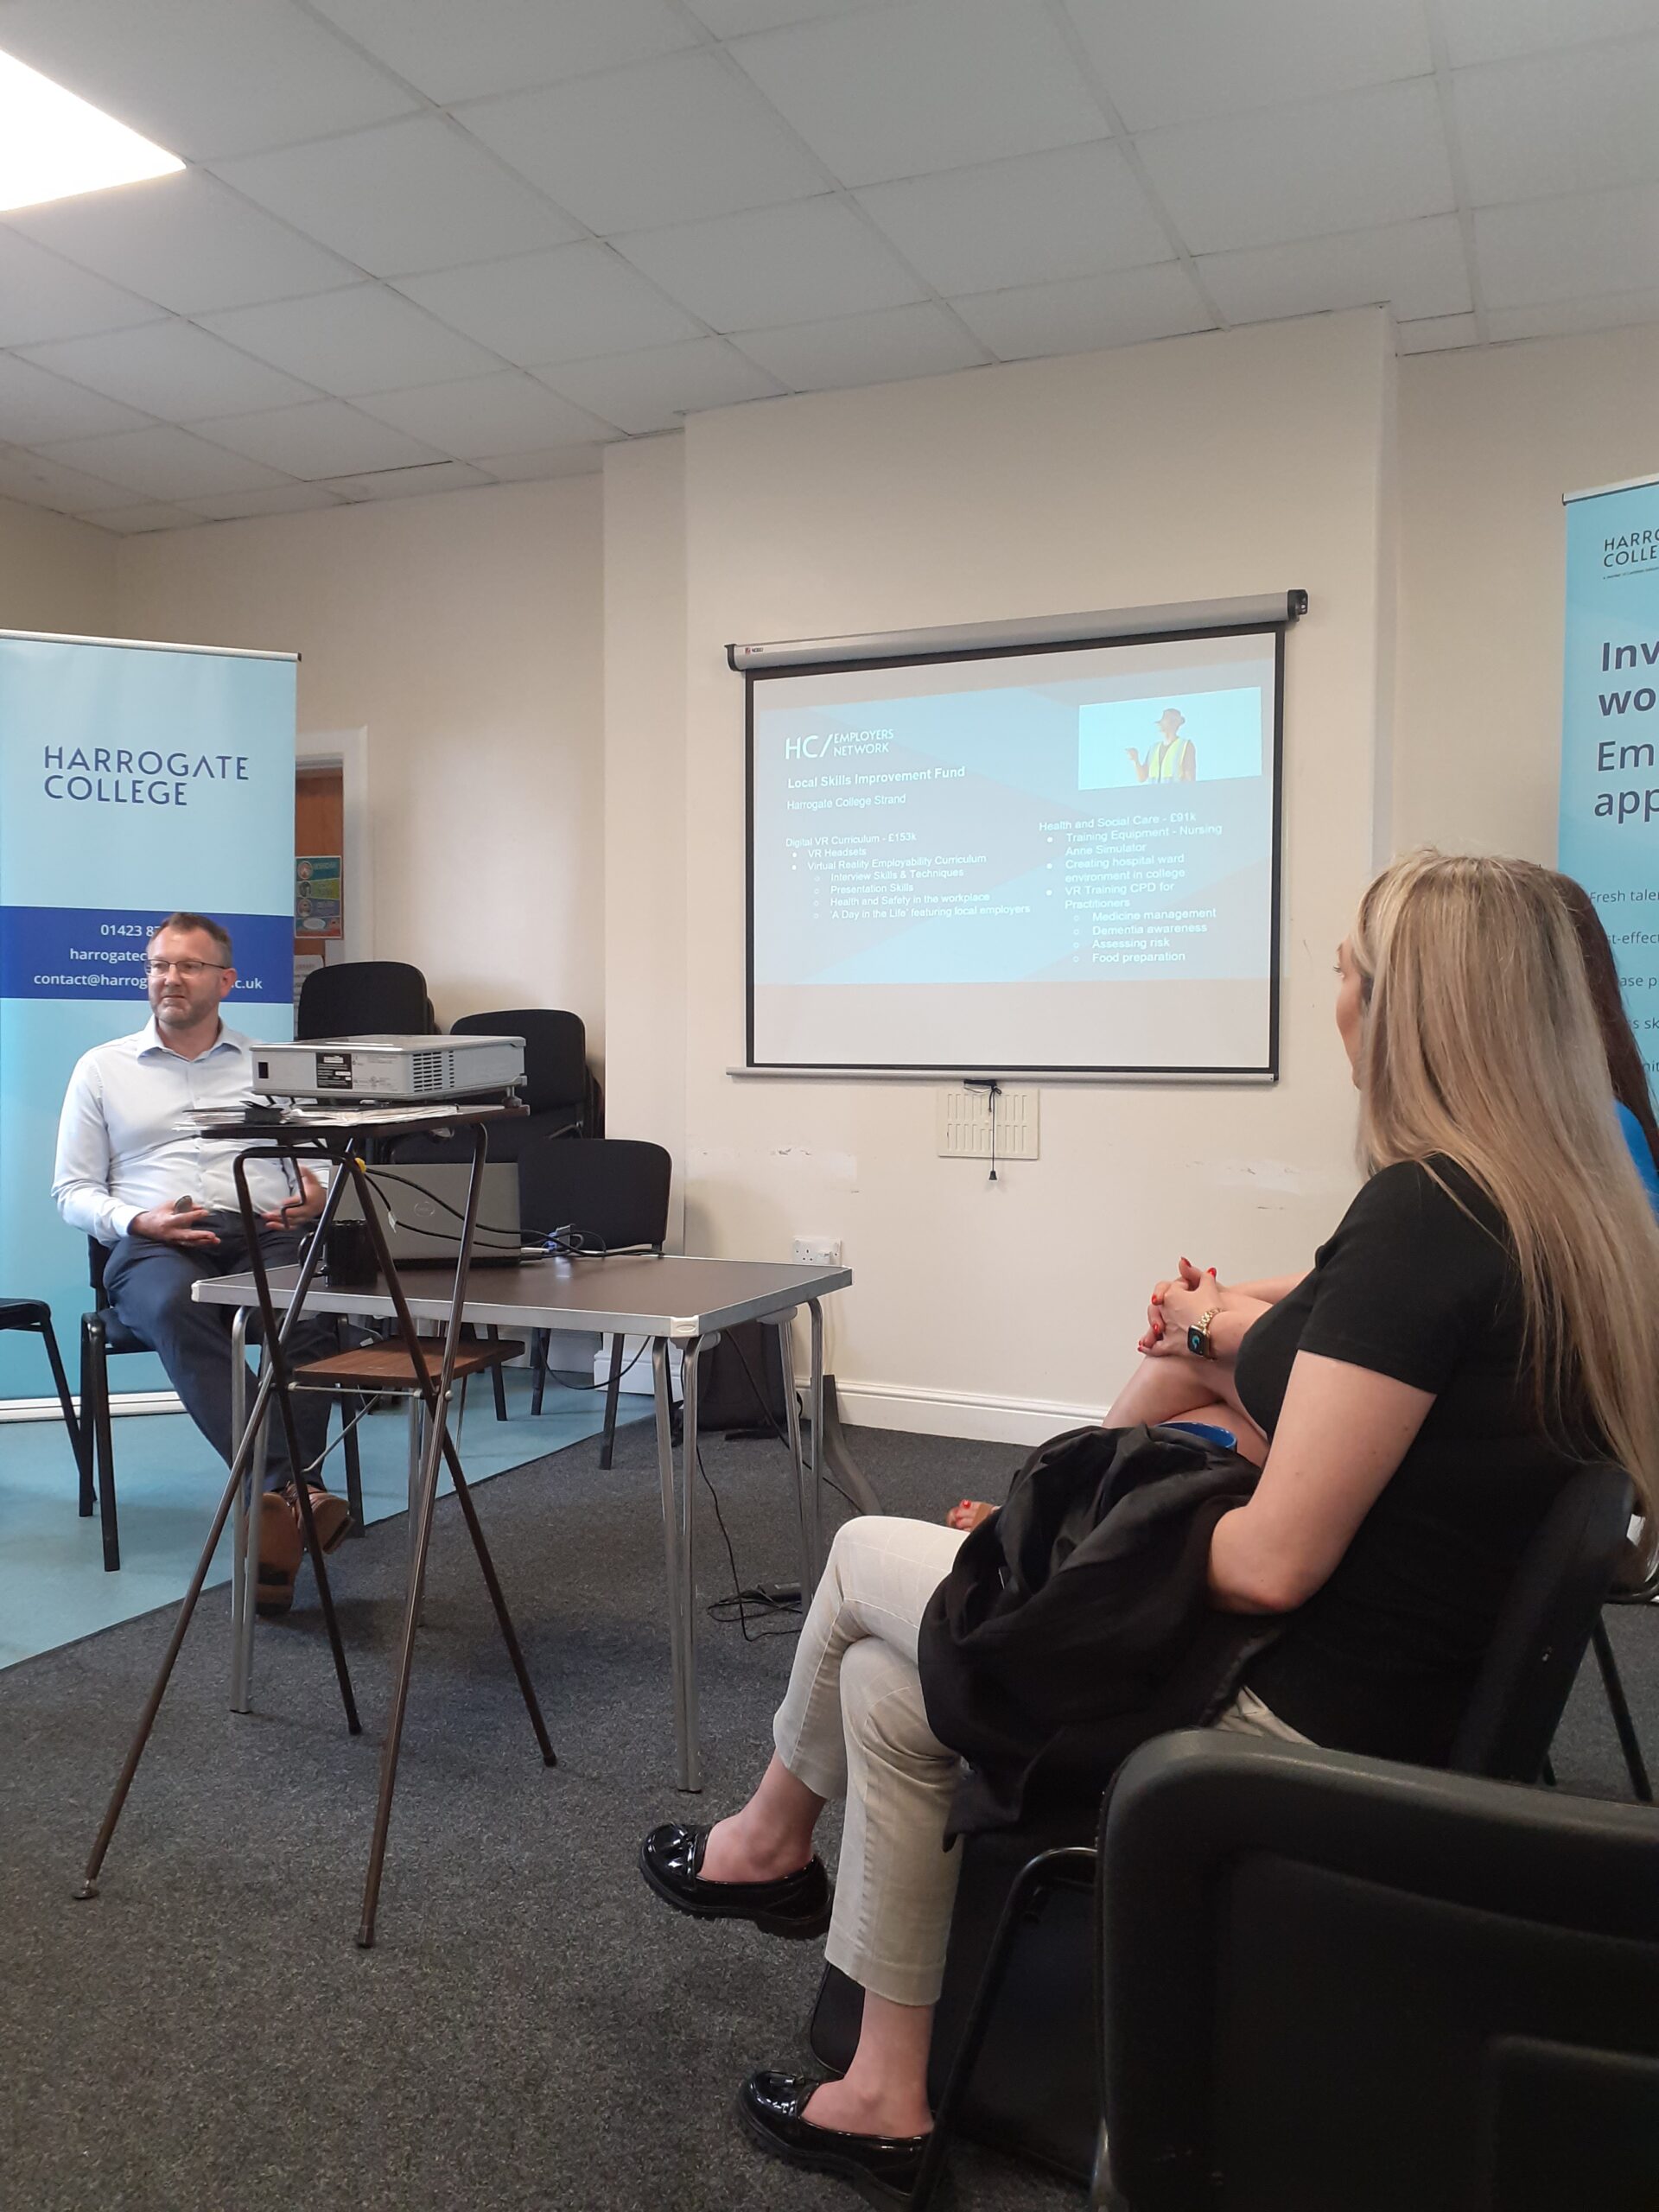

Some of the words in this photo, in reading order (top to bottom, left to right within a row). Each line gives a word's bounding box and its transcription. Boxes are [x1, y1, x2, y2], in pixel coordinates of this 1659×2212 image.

[1604, 545, 1659, 568] COLLE
[1602, 640, 1659, 671] Inv
[1599, 688, 1656, 716] wo
[834, 728, 894, 744] EMPLOYERS
[834, 742, 889, 757] NETWORK
[1598, 741, 1655, 772] Em
[44, 745, 250, 781] HARROGATE
[787, 777, 817, 789] Local
[820, 774, 852, 787] Skills
[855, 769, 931, 786] Improvement
[934, 766, 966, 779] Fund
[44, 774, 188, 806] COLLEGE
[786, 798, 833, 811] Harrogate
[835, 796, 872, 809] College
[874, 793, 906, 805] Strand
[1594, 789, 1659, 824] app
[1039, 820, 1072, 832] Health
[1074, 818, 1095, 830] and
[1097, 815, 1130, 828] Social
[1133, 814, 1160, 825] Care
[1170, 811, 1197, 823] £91k
[785, 837, 813, 849] Digital
[815, 836, 829, 846] VR
[830, 834, 880, 845] Curriculum
[888, 832, 917, 842] £153k
[1067, 831, 1109, 844] Training
[1111, 826, 1169, 842] Equipment
[1179, 823, 1223, 836] Nursing
[808, 849, 823, 858] VR
[824, 847, 868, 858] Headsets
[1065, 845, 1094, 856] Anne
[1096, 842, 1147, 855] Simulator
[807, 861, 836, 871] Virtual
[838, 859, 870, 871] Reality
[871, 857, 932, 869] Employability
[934, 854, 987, 865] Curriculum
[1065, 858, 1109, 870] Creating
[1112, 855, 1154, 868] hospital
[1157, 854, 1185, 865] ward
[830, 872, 872, 882] Interview
[874, 870, 898, 880] Skills
[899, 869, 906, 880] &
[910, 868, 964, 880] Techniques
[1065, 869, 1130, 883] environment
[1133, 869, 1143, 880] in
[1146, 867, 1185, 880] college
[830, 884, 887, 894] Presentation
[889, 882, 914, 893] Skills
[1065, 887, 1082, 896] VR
[1084, 884, 1127, 896] Training
[1130, 882, 1156, 893] CPD
[1160, 881, 1175, 892] for
[1591, 890, 1625, 903] Fresh
[1630, 888, 1659, 902] tale
[830, 897, 860, 907] Health
[861, 896, 879, 906] and
[881, 894, 911, 906] Safety
[912, 894, 922, 904] in
[924, 893, 939, 904] the
[941, 892, 990, 904] workplace
[1065, 898, 1131, 910] Practitioners
[841, 909, 860, 920] Day
[861, 909, 871, 918] in
[872, 907, 887, 918] the
[911, 906, 952, 918] featuring
[954, 905, 977, 916] local
[979, 904, 1031, 917] employers
[1092, 910, 1141, 922] Medicine
[1143, 907, 1217, 921] management
[100, 924, 143, 937] 01423
[1092, 925, 1145, 937] Dementia
[1147, 923, 1208, 934] awareness
[1092, 938, 1147, 950] Assessing
[1150, 937, 1171, 948] risk
[70, 948, 147, 963] harrogatec
[1092, 951, 1120, 963] Food
[1122, 949, 1186, 963] preparation
